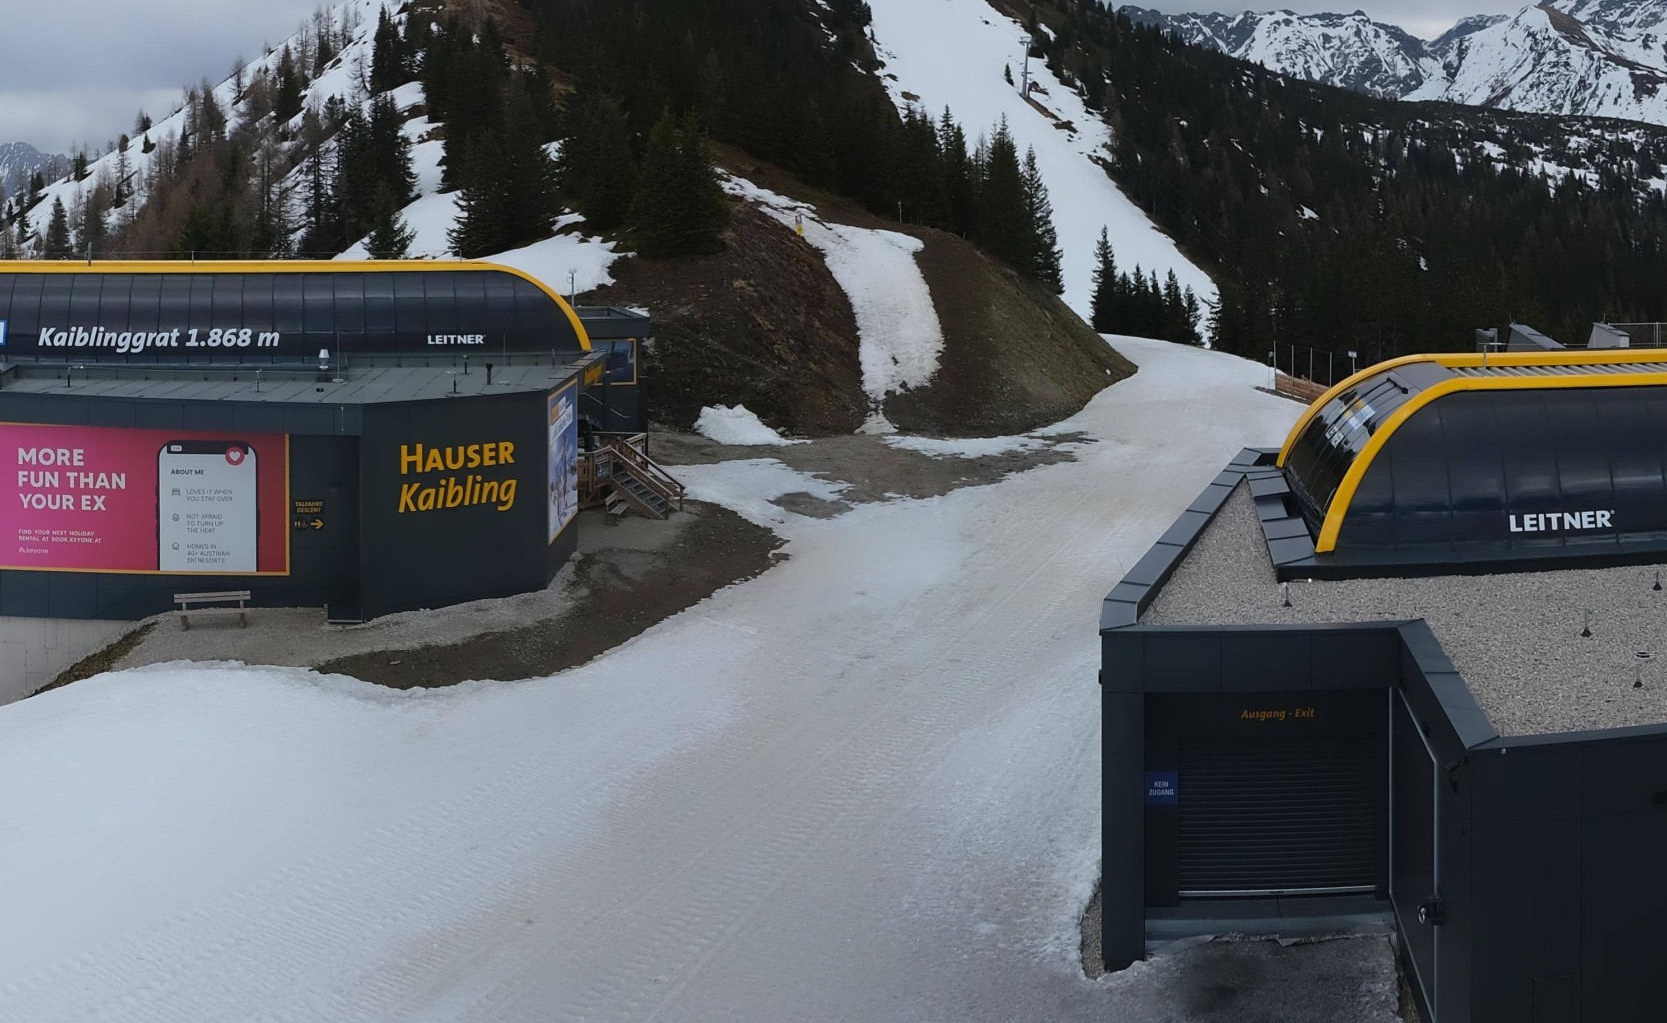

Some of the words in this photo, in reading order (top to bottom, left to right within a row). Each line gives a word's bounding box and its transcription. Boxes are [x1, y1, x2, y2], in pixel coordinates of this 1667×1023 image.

[38, 326, 180, 353] Kaiblinggrat
[185, 327, 252, 347] 1.868
[257, 331, 280, 347] m
[18, 448, 84, 466] MORE
[400, 441, 516, 475] HAUSER
[18, 471, 59, 488] FUN
[66, 472, 126, 489] THAN
[19, 493, 75, 510] YOUR
[81, 495, 106, 511] EX
[398, 474, 517, 513] Kaibling
[26, 547, 49, 555] keyone
[1241, 708, 1287, 721] Ausgang
[1295, 707, 1316, 718] Exit
[1148, 788, 1174, 796] ZUGANG
[1153, 780, 1169, 788] KEIN
